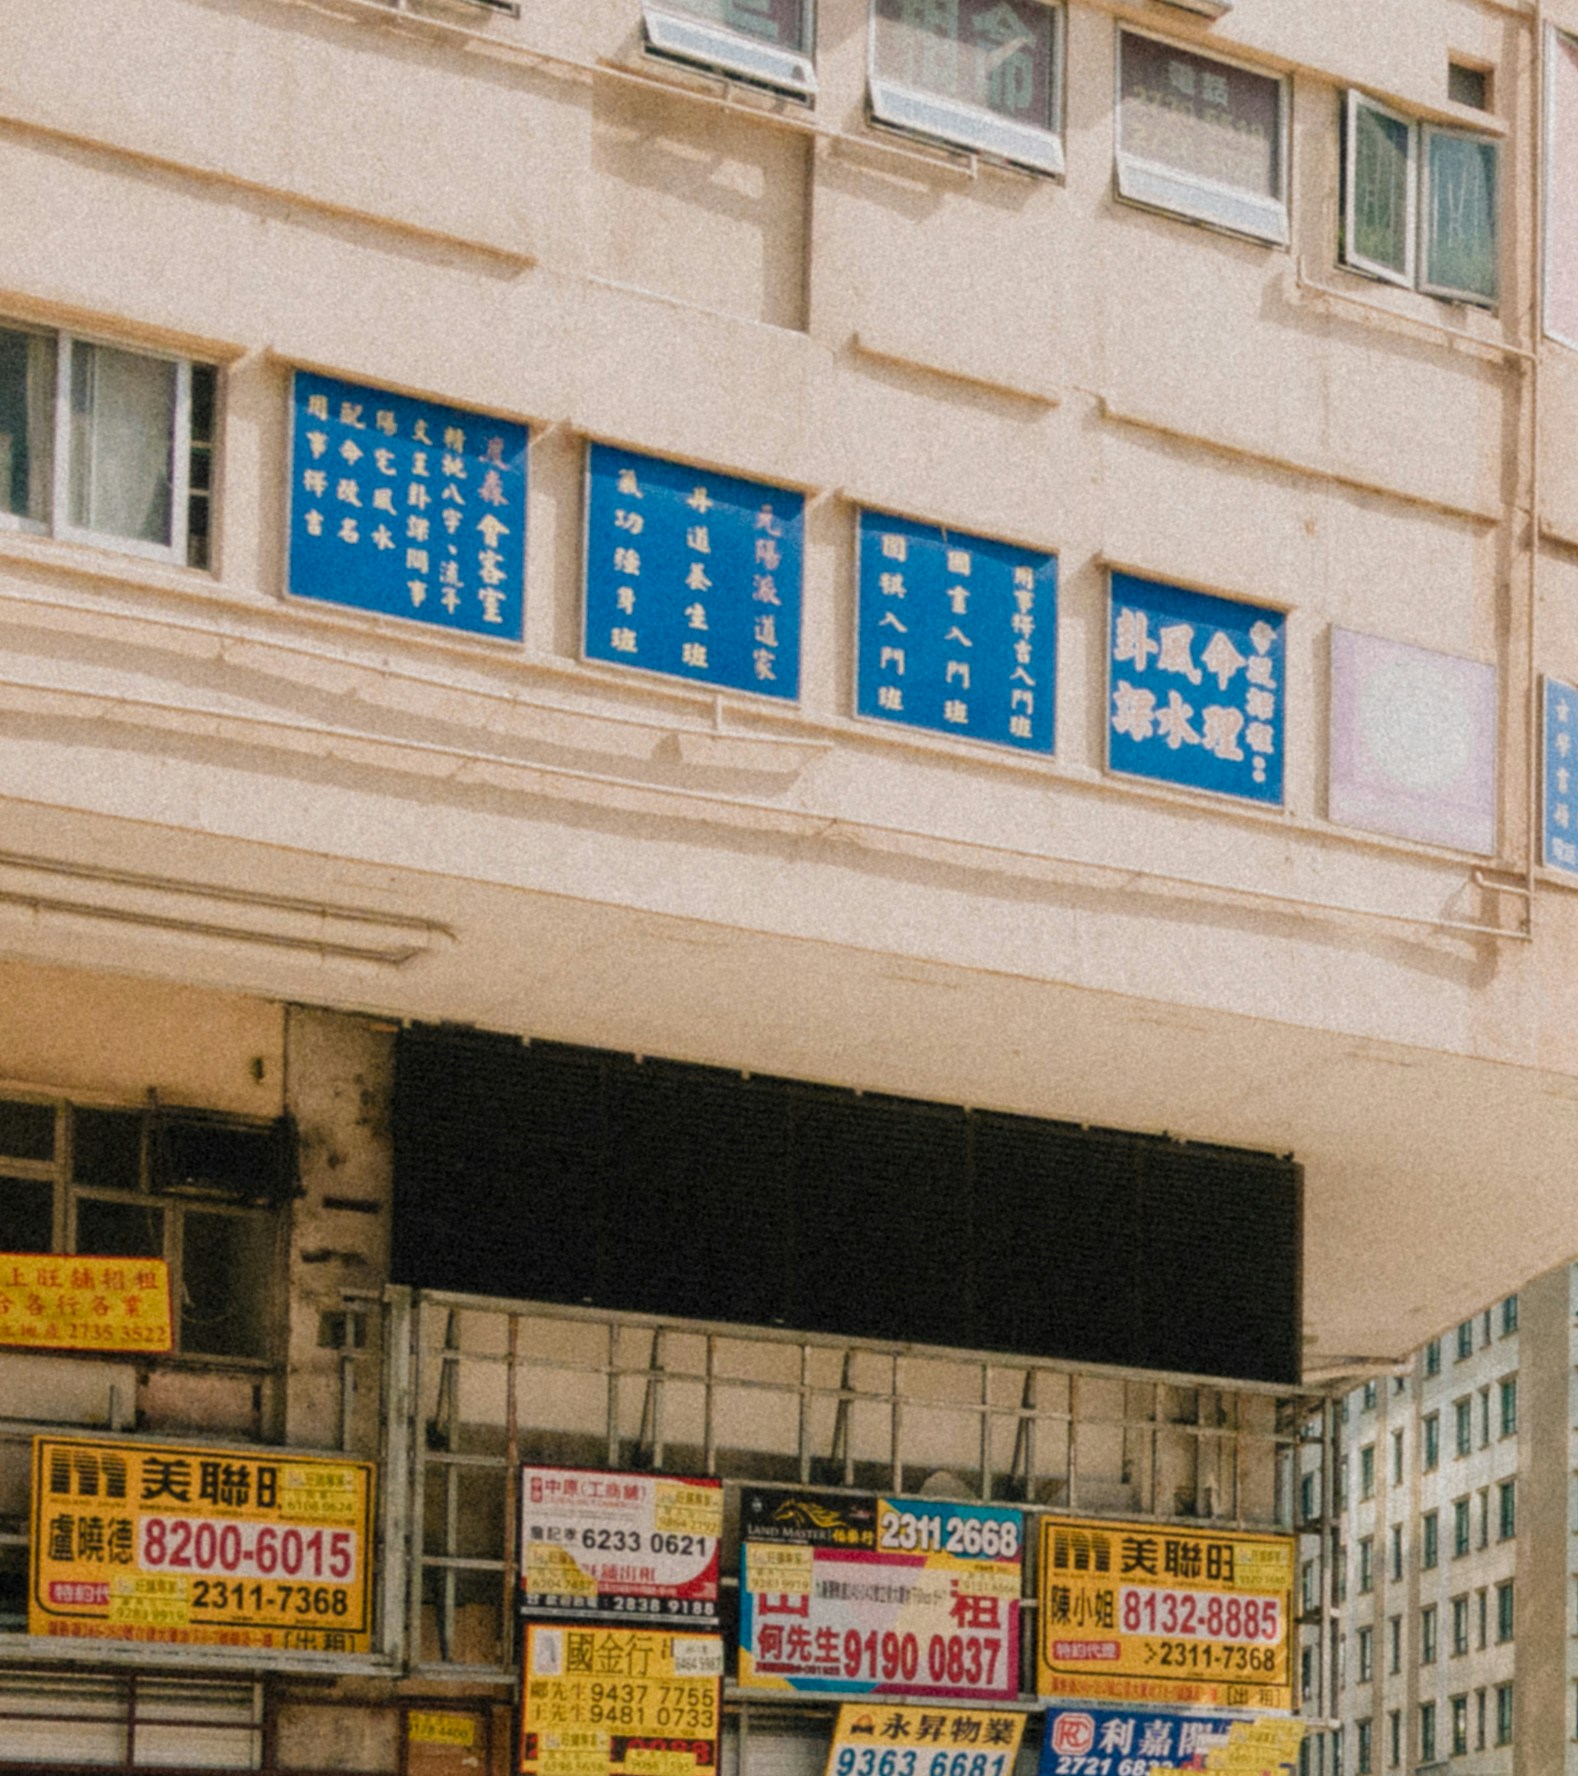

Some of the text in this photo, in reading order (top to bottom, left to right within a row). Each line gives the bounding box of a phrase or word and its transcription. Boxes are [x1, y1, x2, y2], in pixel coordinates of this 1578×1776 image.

[1155, 624, 1201, 749] 風水
[69, 1323, 167, 1344] 2735 3522
[582, 1527, 707, 1557] 6233 0621
[748, 1525, 780, 1536] LAND
[782, 1526, 828, 1540] MASTER
[881, 1512, 1019, 1558] 2311 2668
[144, 1518, 352, 1579] 8200-6015
[192, 1580, 348, 1616] 2311-7368
[614, 1596, 660, 1613] 2838
[668, 1599, 715, 1616] 9188
[1051, 1585, 1278, 1640] 陳小姐 8132-8885
[567, 1632, 654, 1677] 國金行
[757, 1624, 1002, 1685] 何先生 9190 0837
[1159, 1641, 1276, 1672] 2311-7368
[591, 1682, 715, 1708] 9437 7755
[590, 1704, 646, 1725] 9481
[656, 1707, 714, 1728] 0733
[880, 1713, 1016, 1745] 永昇物業
[1055, 1757, 1113, 1776] 2721
